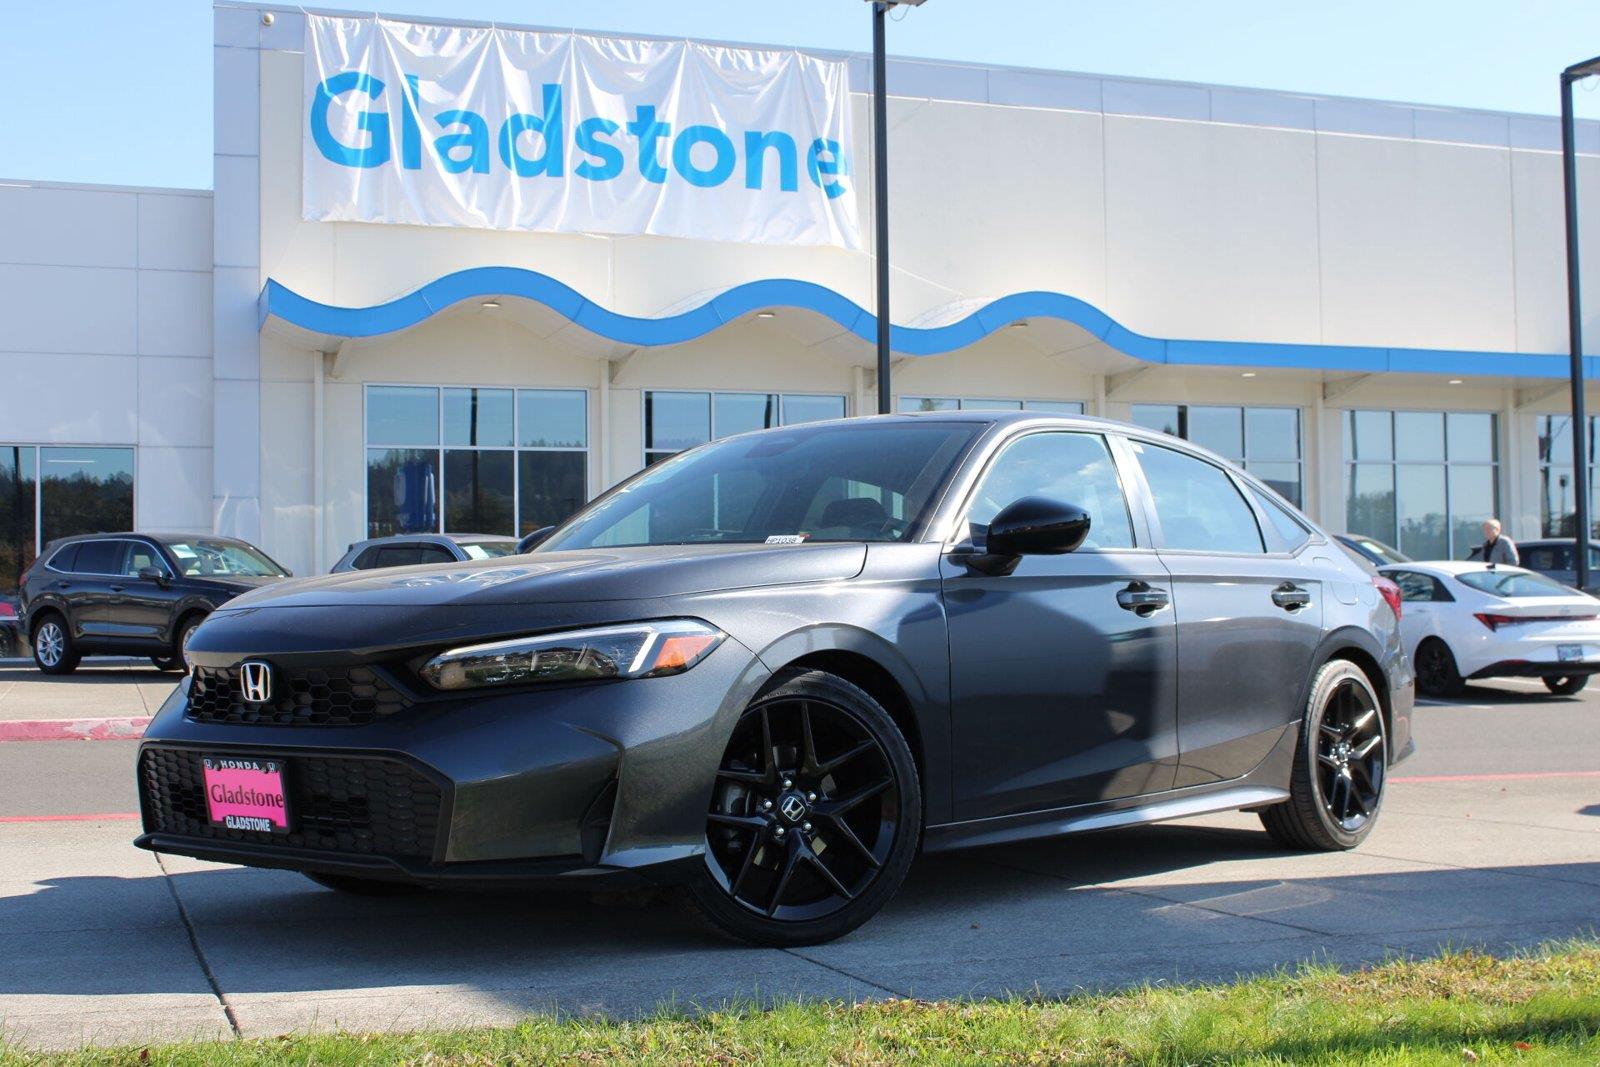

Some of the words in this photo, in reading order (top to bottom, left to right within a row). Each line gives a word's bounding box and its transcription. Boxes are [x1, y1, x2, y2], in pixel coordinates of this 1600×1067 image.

[310, 71, 848, 200] Gladstone
[220, 760, 260, 770] HONDA
[211, 784, 284, 808] Gladstone
[226, 816, 271, 831] GLADSTONE
